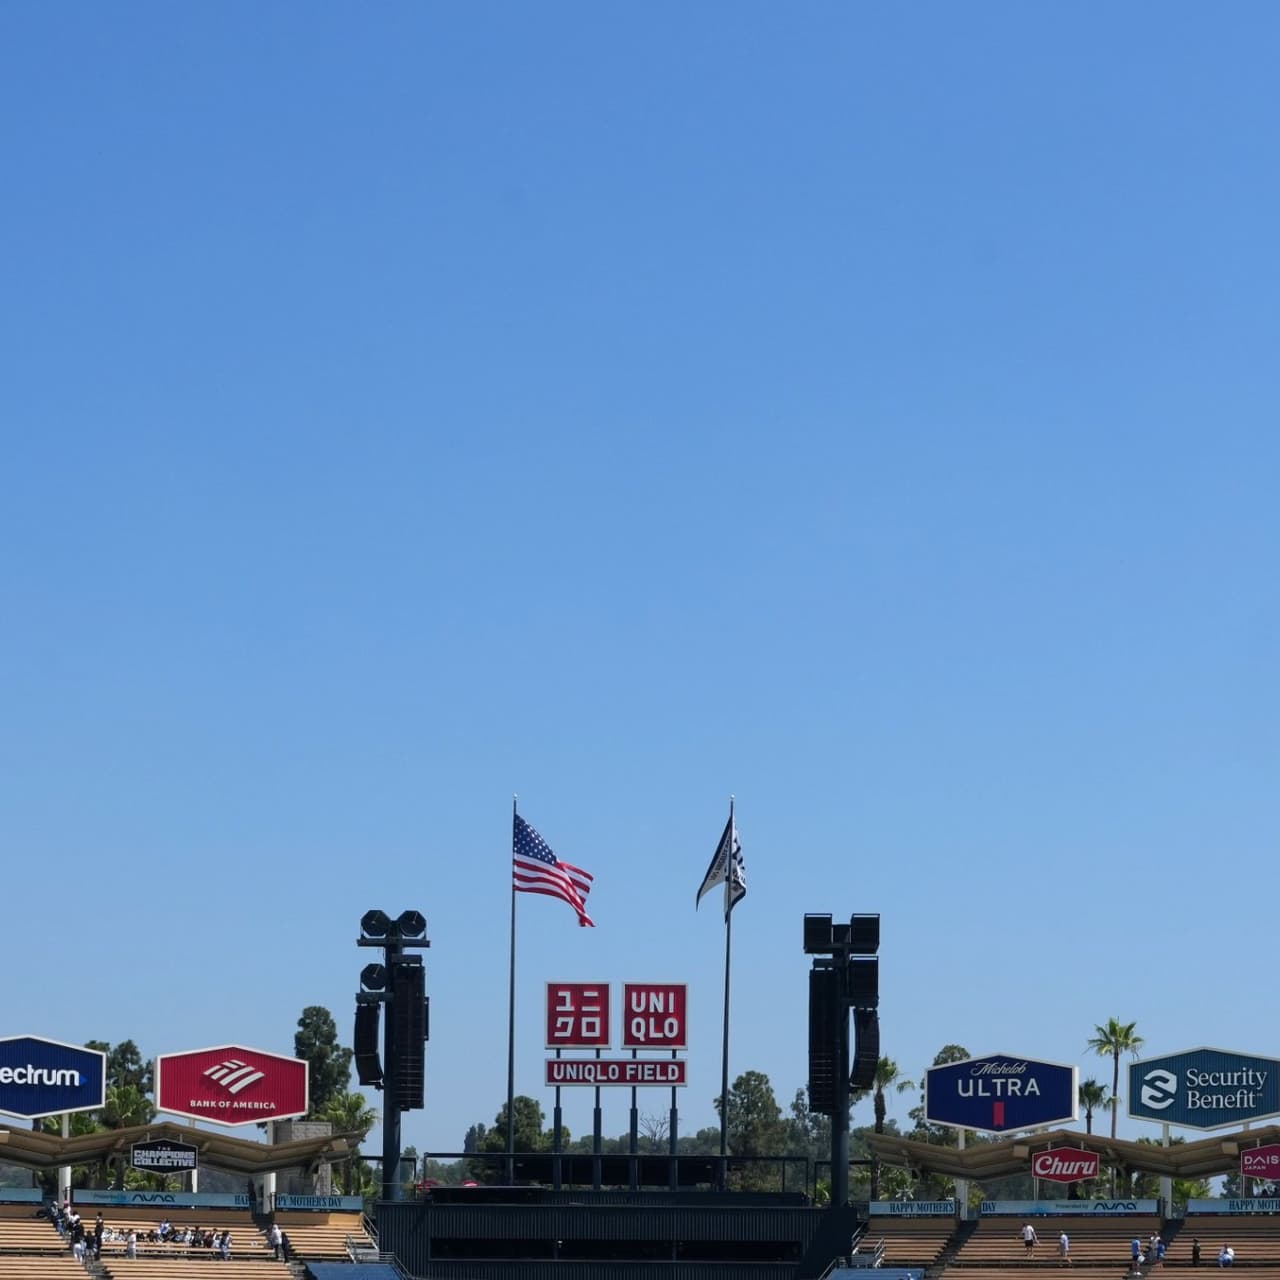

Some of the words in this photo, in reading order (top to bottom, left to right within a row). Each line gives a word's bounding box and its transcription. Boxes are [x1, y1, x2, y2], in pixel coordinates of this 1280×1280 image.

[556, 990, 601, 1012] ユニ
[630, 991, 675, 1014] UNI
[553, 1016, 601, 1038] クロ
[630, 1016, 680, 1042] QLO
[552, 1063, 619, 1083] UNIQLO
[625, 1064, 680, 1081] FIELD
[970, 1061, 1027, 1078] Michelob
[1186, 1066, 1268, 1090] Security
[957, 1077, 1041, 1098] ULTRA
[190, 1099, 217, 1108] BANK
[219, 1100, 231, 1109] OF
[232, 1101, 276, 1110] AMERICA
[1186, 1090, 1258, 1110] Benefit
[133, 1150, 196, 1160] CHAMPIONS
[133, 1158, 196, 1168] COLLECTIVE
[1034, 1155, 1096, 1176] Churu
[889, 1202, 918, 1213] HAPPY
[919, 1202, 955, 1213] MOTHER'S
[982, 1202, 997, 1212] DAY
